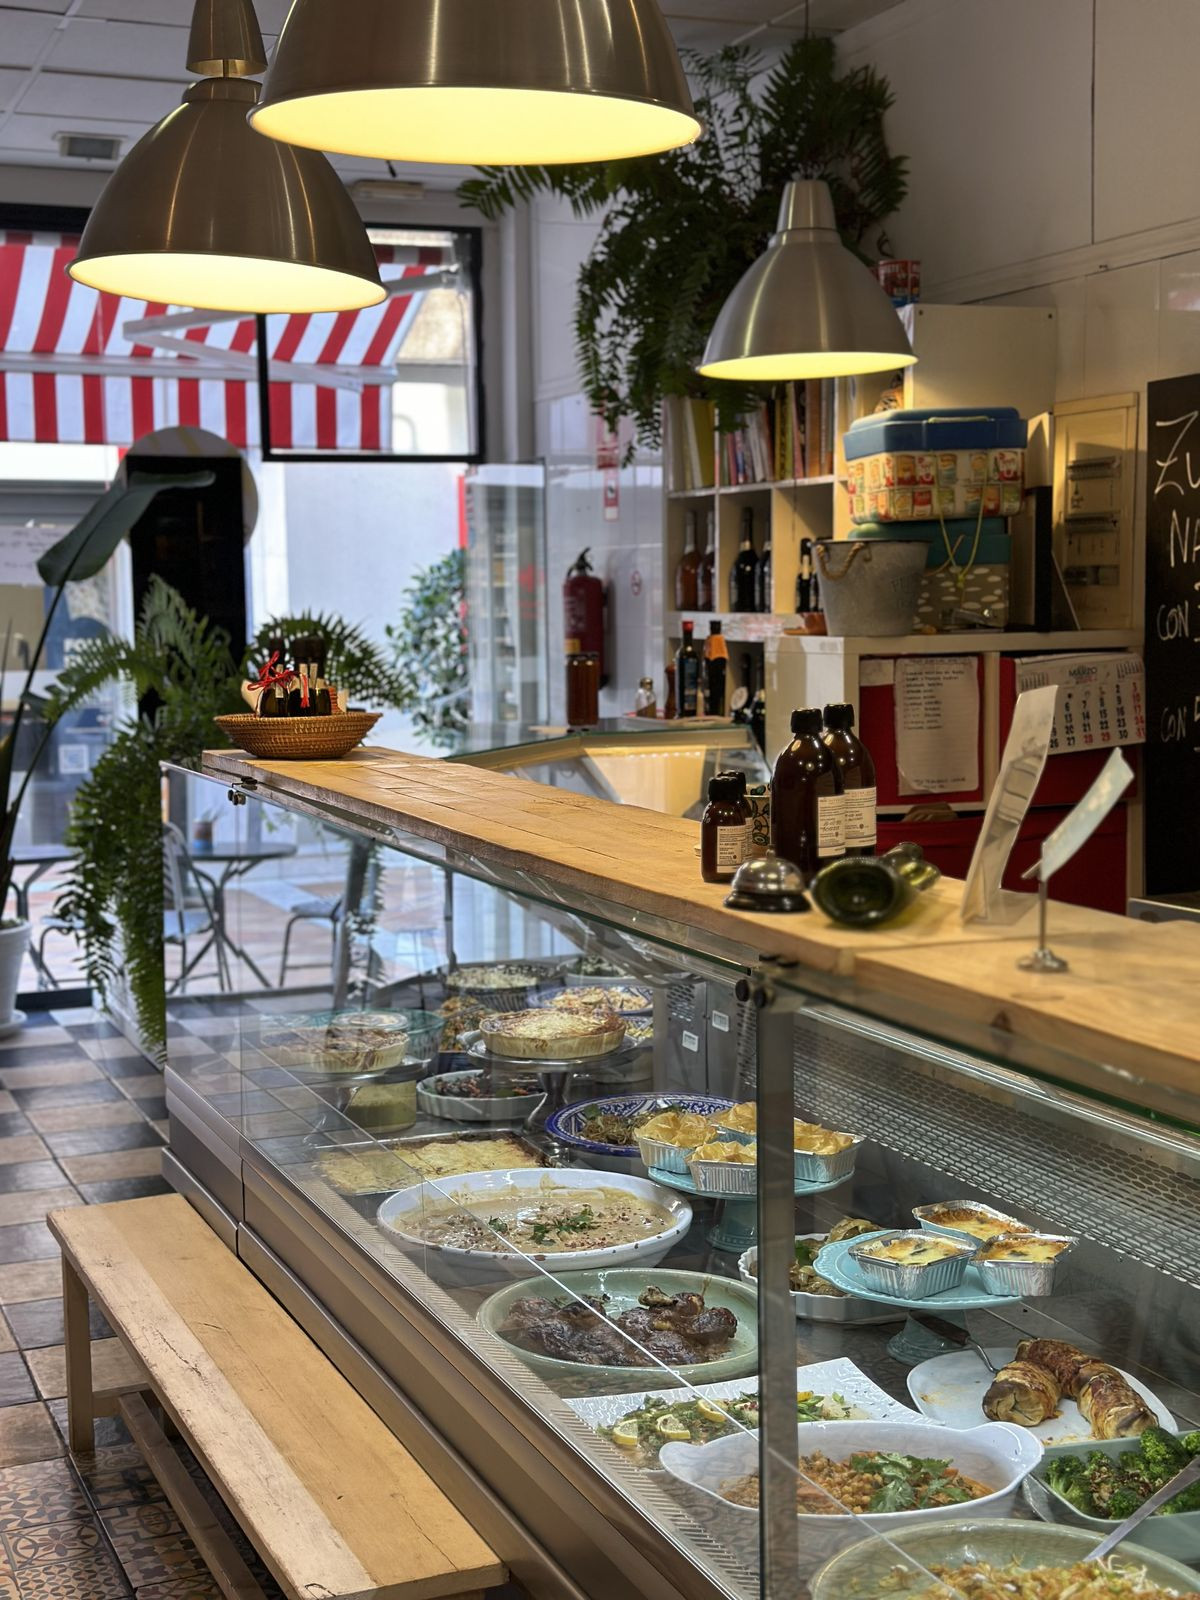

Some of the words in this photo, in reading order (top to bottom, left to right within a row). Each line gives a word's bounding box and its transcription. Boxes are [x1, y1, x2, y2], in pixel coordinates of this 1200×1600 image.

[1157, 600, 1190, 641] CON
[1081, 710, 1091, 721] 14
[1099, 708, 1108, 719] 15
[1160, 706, 1188, 743] CON
[1065, 724, 1074, 735] 20
[1081, 722, 1091, 733] 21
[1099, 720, 1109, 731] 22
[1116, 718, 1126, 729] 23
[1049, 737, 1059, 749] 26
[1066, 735, 1076, 747] 27
[1118, 728, 1129, 740] 30
